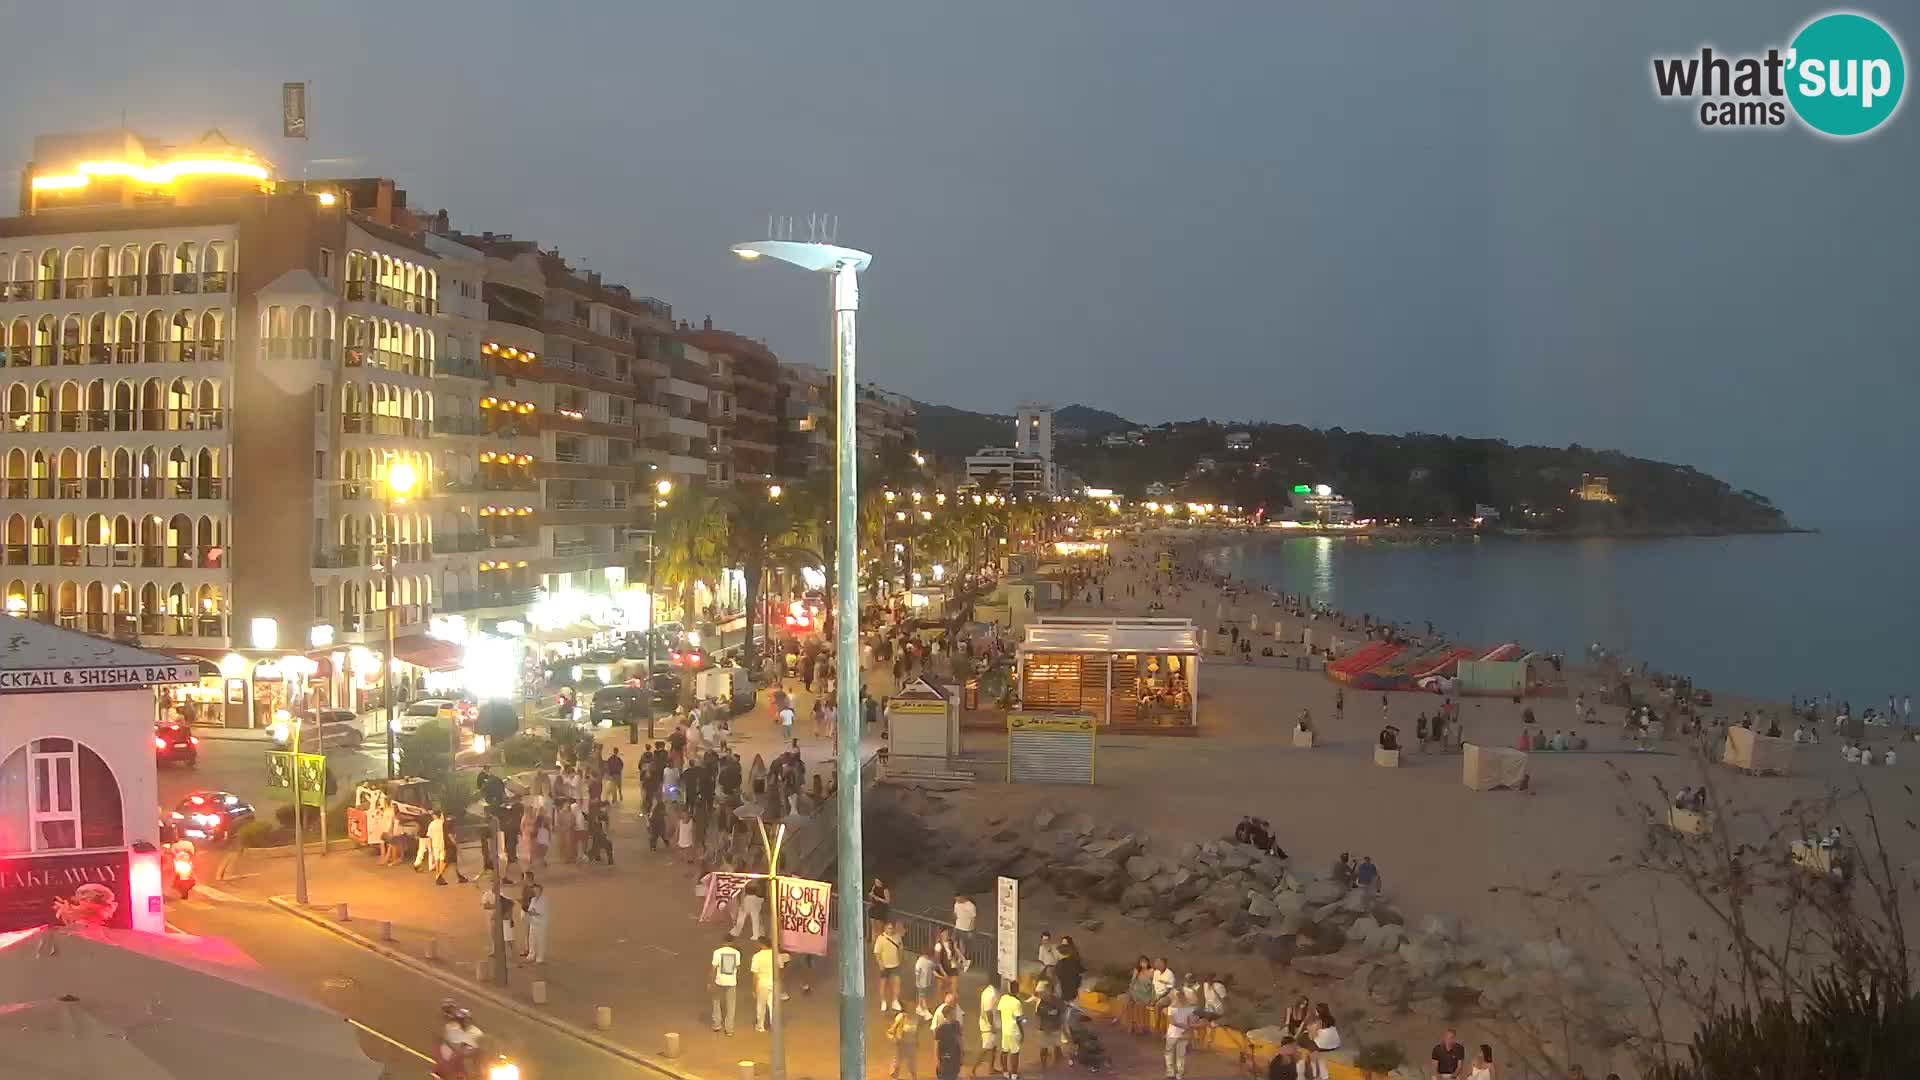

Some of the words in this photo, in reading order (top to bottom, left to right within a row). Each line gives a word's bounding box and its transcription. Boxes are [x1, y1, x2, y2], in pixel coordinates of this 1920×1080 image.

[0, 671, 57, 687] CKTAIL
[63, 671, 74, 684] &
[79, 668, 141, 684] SHISHA
[145, 667, 177, 681] BAR
[780, 882, 820, 905] LLORET
[779, 898, 818, 918] ENJOY
[780, 914, 827, 936] RESPECT
